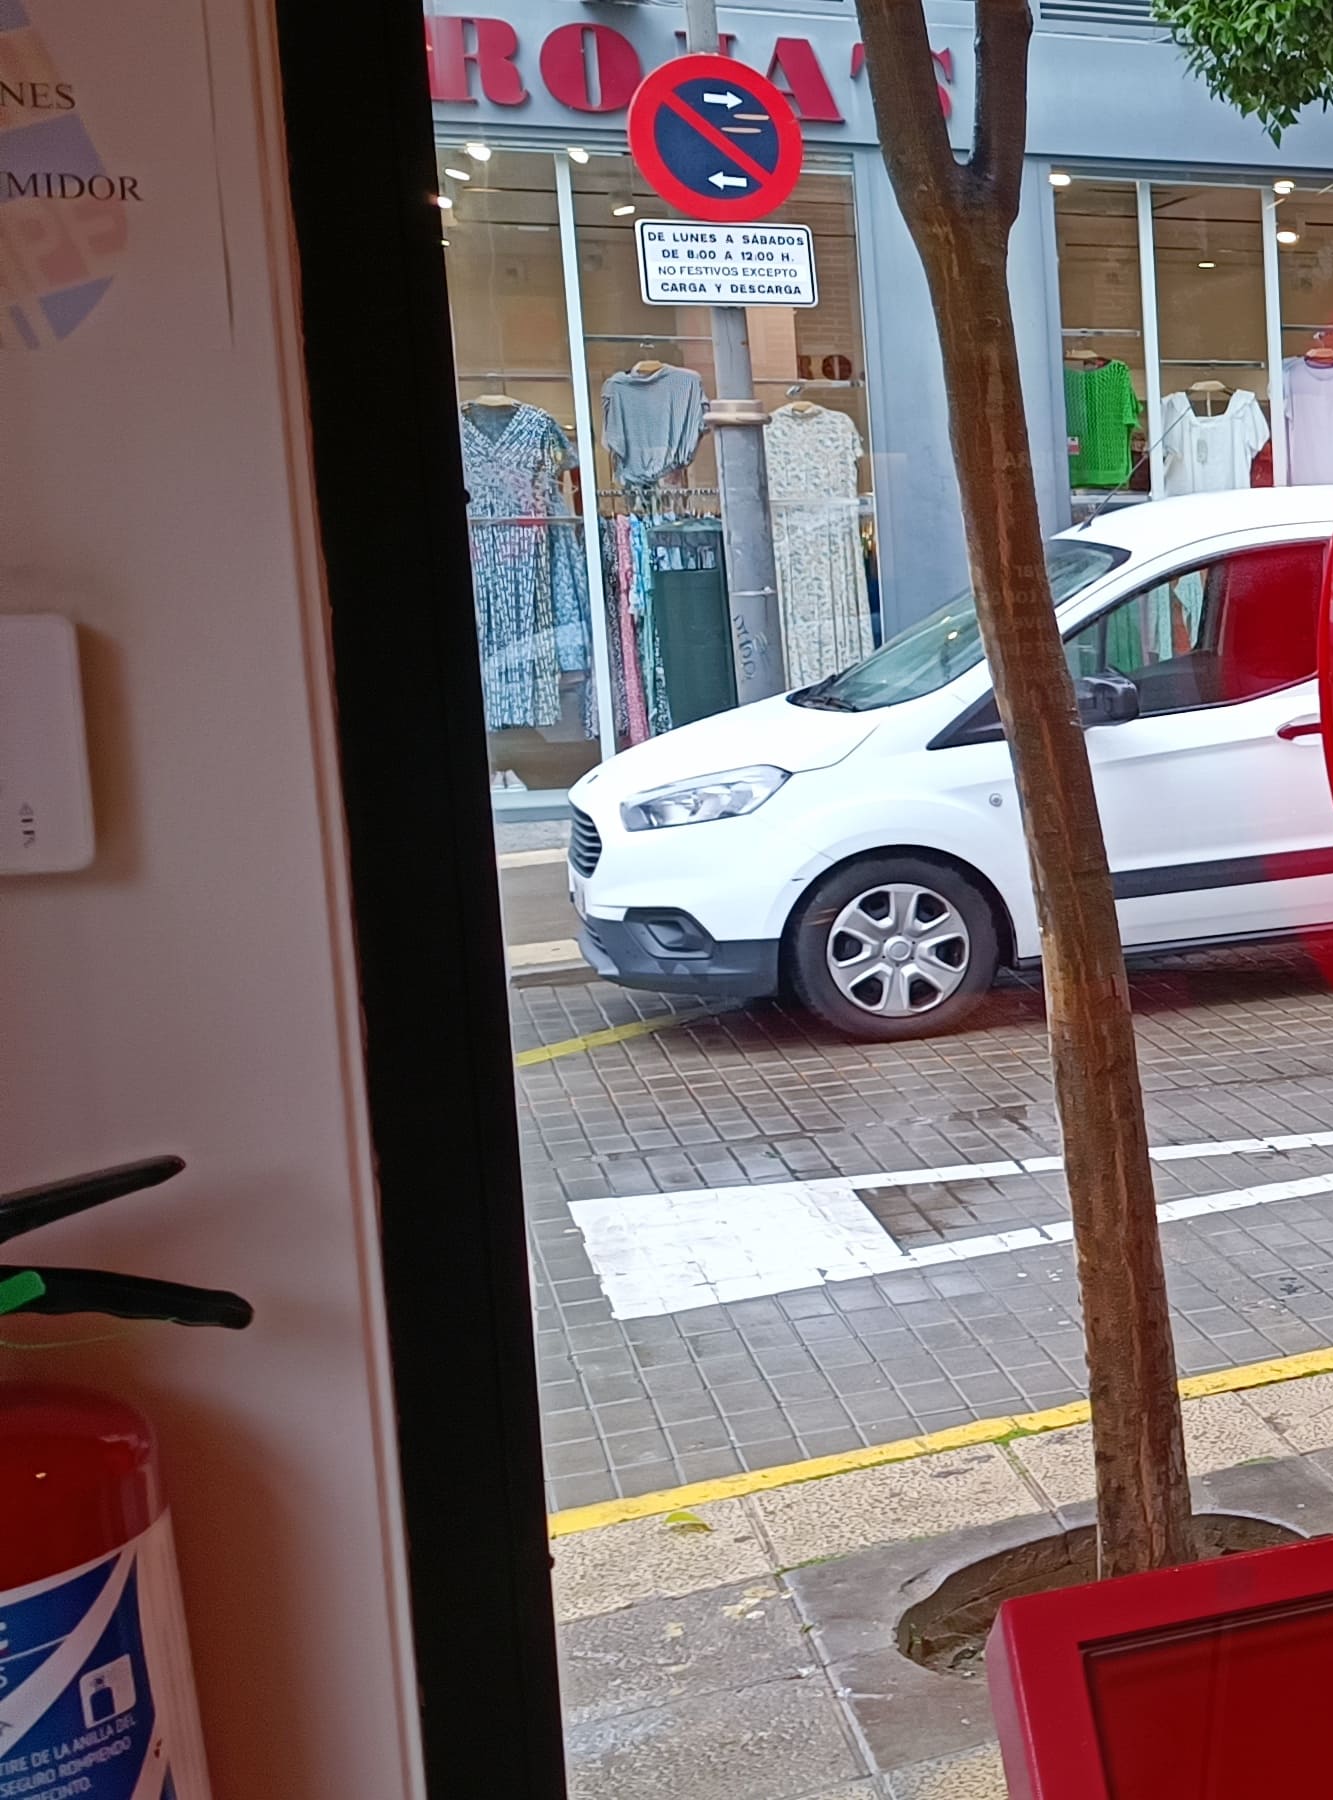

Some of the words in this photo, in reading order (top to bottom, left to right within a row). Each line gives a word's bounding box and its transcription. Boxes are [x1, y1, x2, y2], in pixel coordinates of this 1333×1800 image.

[0, 171, 143, 201] MIDOR
[648, 231, 665, 242] DE
[673, 232, 717, 243] LUNES
[726, 234, 734, 244] A
[662, 249, 680, 259] DE
[725, 250, 733, 260] A
[781, 252, 794, 262] H.
[658, 266, 676, 275] NO
[680, 266, 739, 276] FESTIVOS
[742, 267, 798, 278] EXCEPTO
[661, 282, 707, 293] CARGA
[715, 283, 722, 293] Y
[730, 284, 802, 295] DESCARGA
[30, 1748, 50, 1767] DE
[52, 1742, 72, 1760] LA
[0, 1768, 56, 1798] SEGURO
